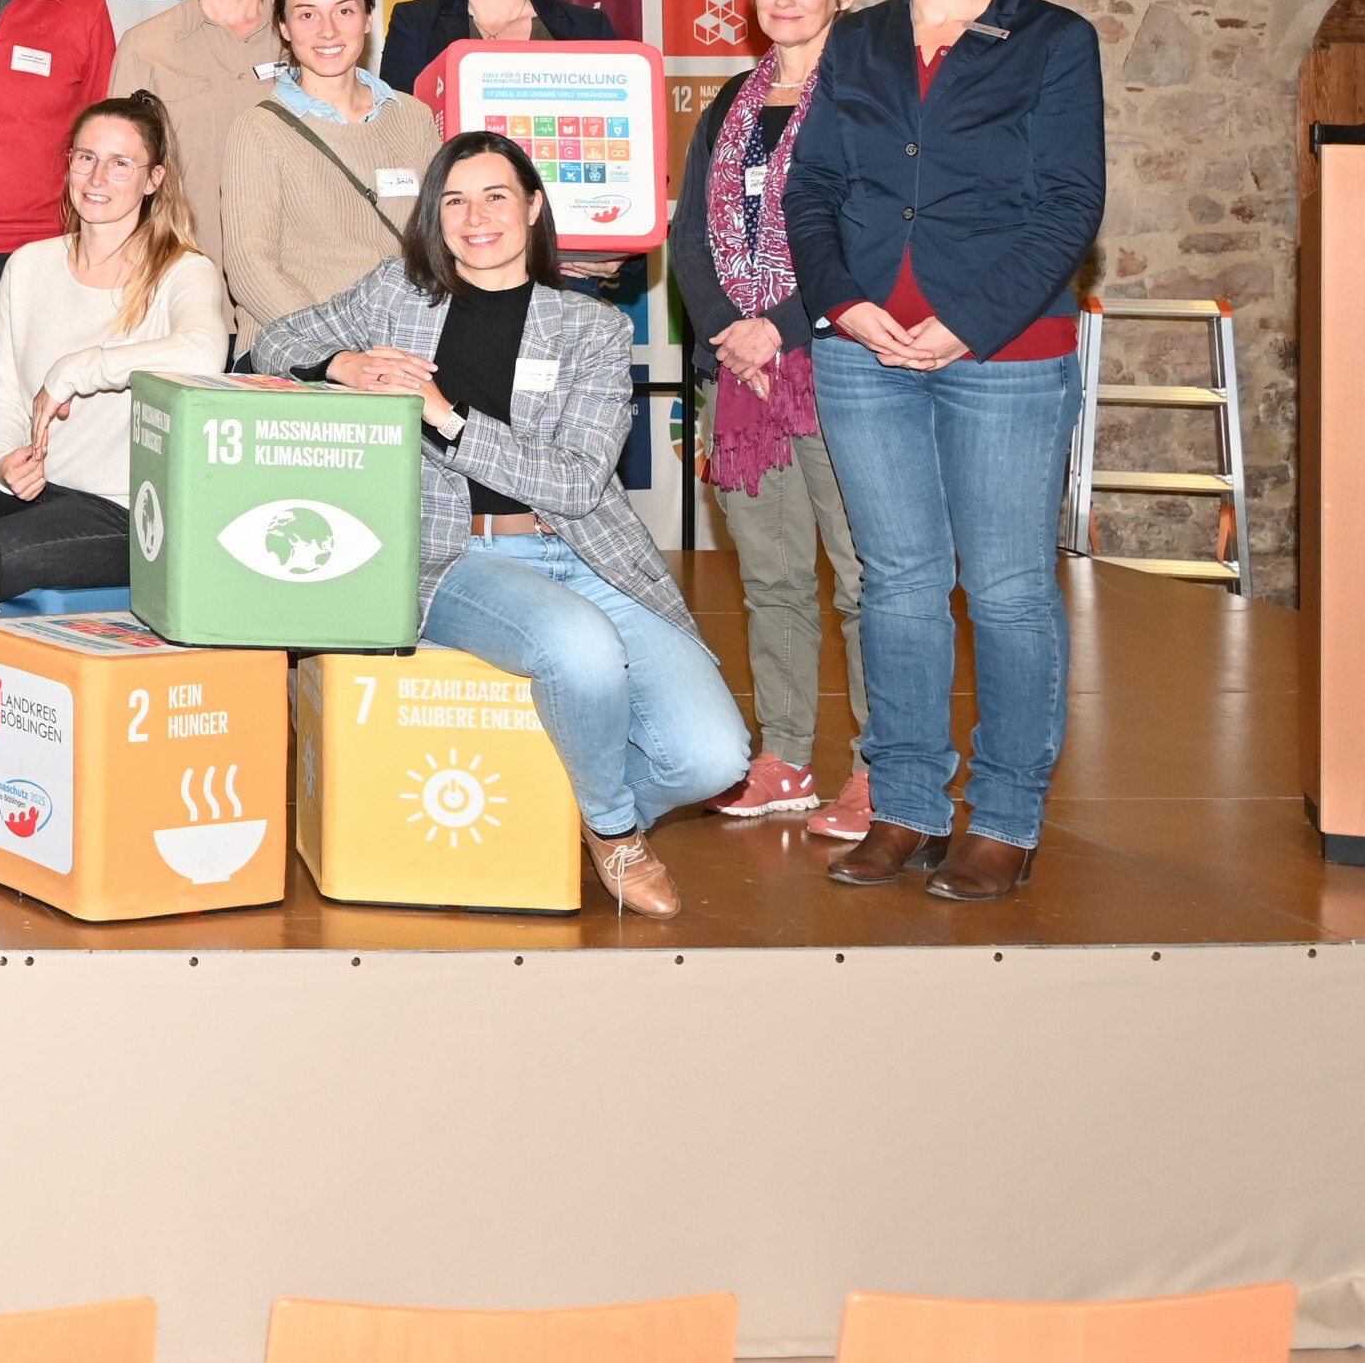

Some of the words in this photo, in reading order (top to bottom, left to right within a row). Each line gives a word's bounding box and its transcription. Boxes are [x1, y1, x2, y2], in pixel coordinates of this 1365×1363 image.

[523, 73, 627, 85] ENTWICKLUNG
[672, 85, 693, 113] 12
[203, 418, 243, 465] 13
[255, 419, 366, 444] MASSNAHMEN
[369, 424, 403, 445] ZUM
[255, 445, 364, 470] KLIMASCHUTZ
[168, 683, 202, 709] KEIN
[354, 676, 376, 725] 7
[398, 678, 510, 703] BEZAHLBARE
[0, 690, 57, 724] LANDKREIS
[128, 689, 150, 742] 2
[398, 705, 477, 729] SAUBERE
[481, 708, 544, 731] ENERG
[0, 709, 62, 744] BÖBLINGEN
[168, 711, 228, 739] HUNGER
[4, 793, 26, 809] Böblingen
[30, 792, 46, 807] 2025
